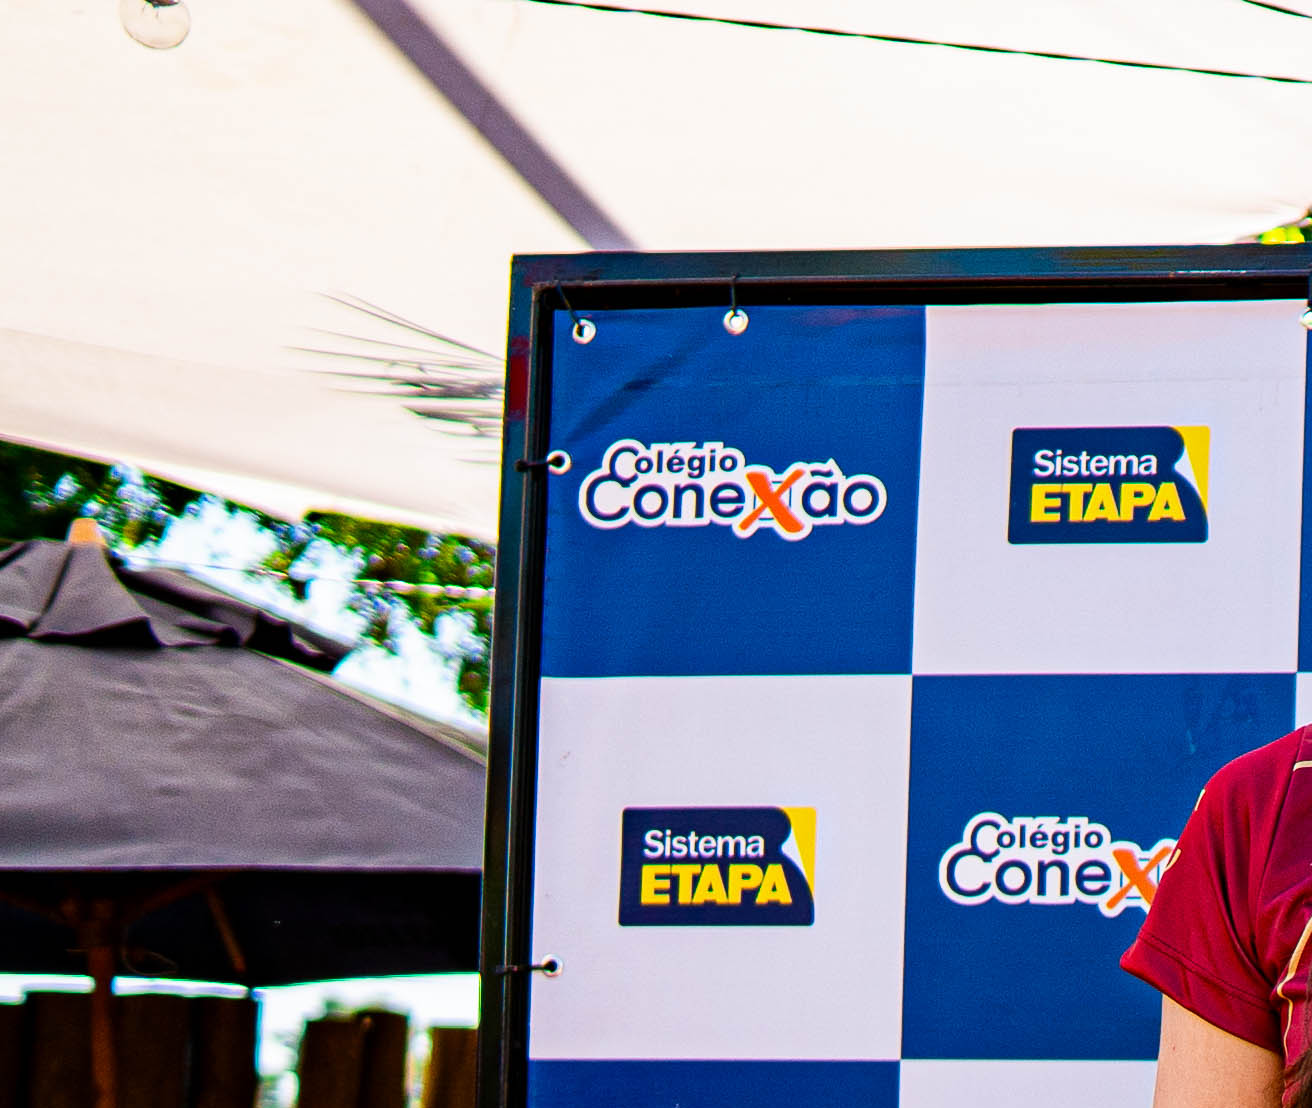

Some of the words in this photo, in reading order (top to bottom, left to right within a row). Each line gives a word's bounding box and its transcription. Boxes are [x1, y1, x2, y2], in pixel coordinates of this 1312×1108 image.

[609, 446, 739, 482] Colégio
[1033, 449, 1158, 477] Sistema
[1030, 483, 1186, 522] ETAPA
[643, 829, 765, 858] Sistema
[970, 820, 1104, 856] Colégio
[640, 864, 793, 905] ETAPA
